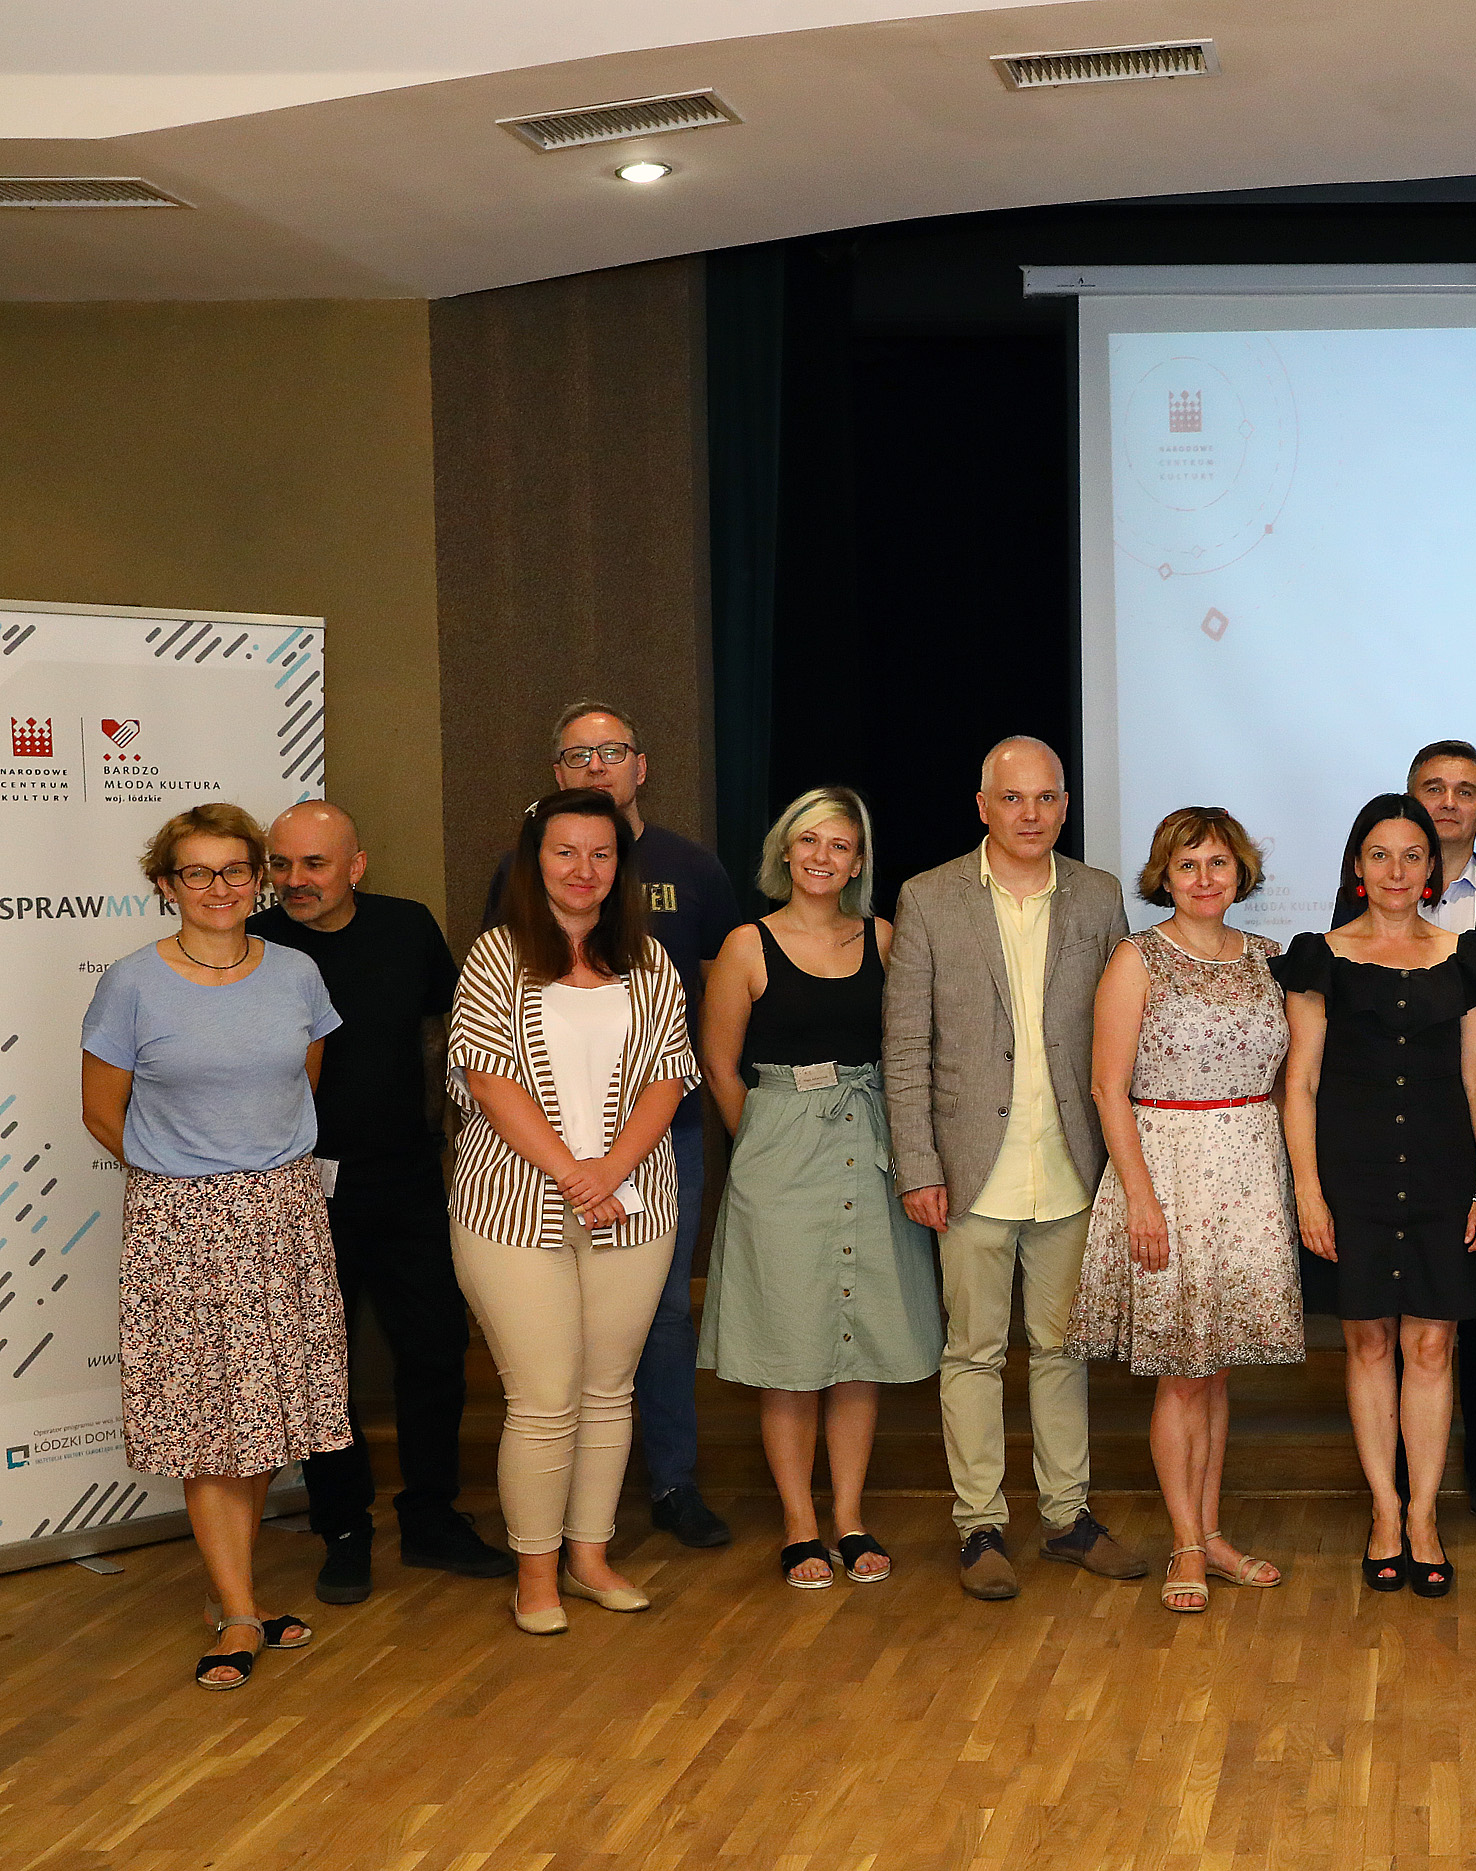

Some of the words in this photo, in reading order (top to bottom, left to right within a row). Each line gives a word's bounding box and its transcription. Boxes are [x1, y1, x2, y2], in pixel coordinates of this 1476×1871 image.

[0, 768, 68, 776] NARODOWE
[104, 766, 159, 775] BARDZO
[1, 781, 68, 789] CENTRUM
[104, 780, 154, 789] MŁODA
[160, 781, 221, 790] KULTURA
[2, 794, 69, 802] KULTURY
[105, 795, 125, 803] woj.
[0, 895, 150, 920] SPRAWMY
[34, 1435, 81, 1453] ŁÓDZKI
[85, 1429, 116, 1444] DOM
